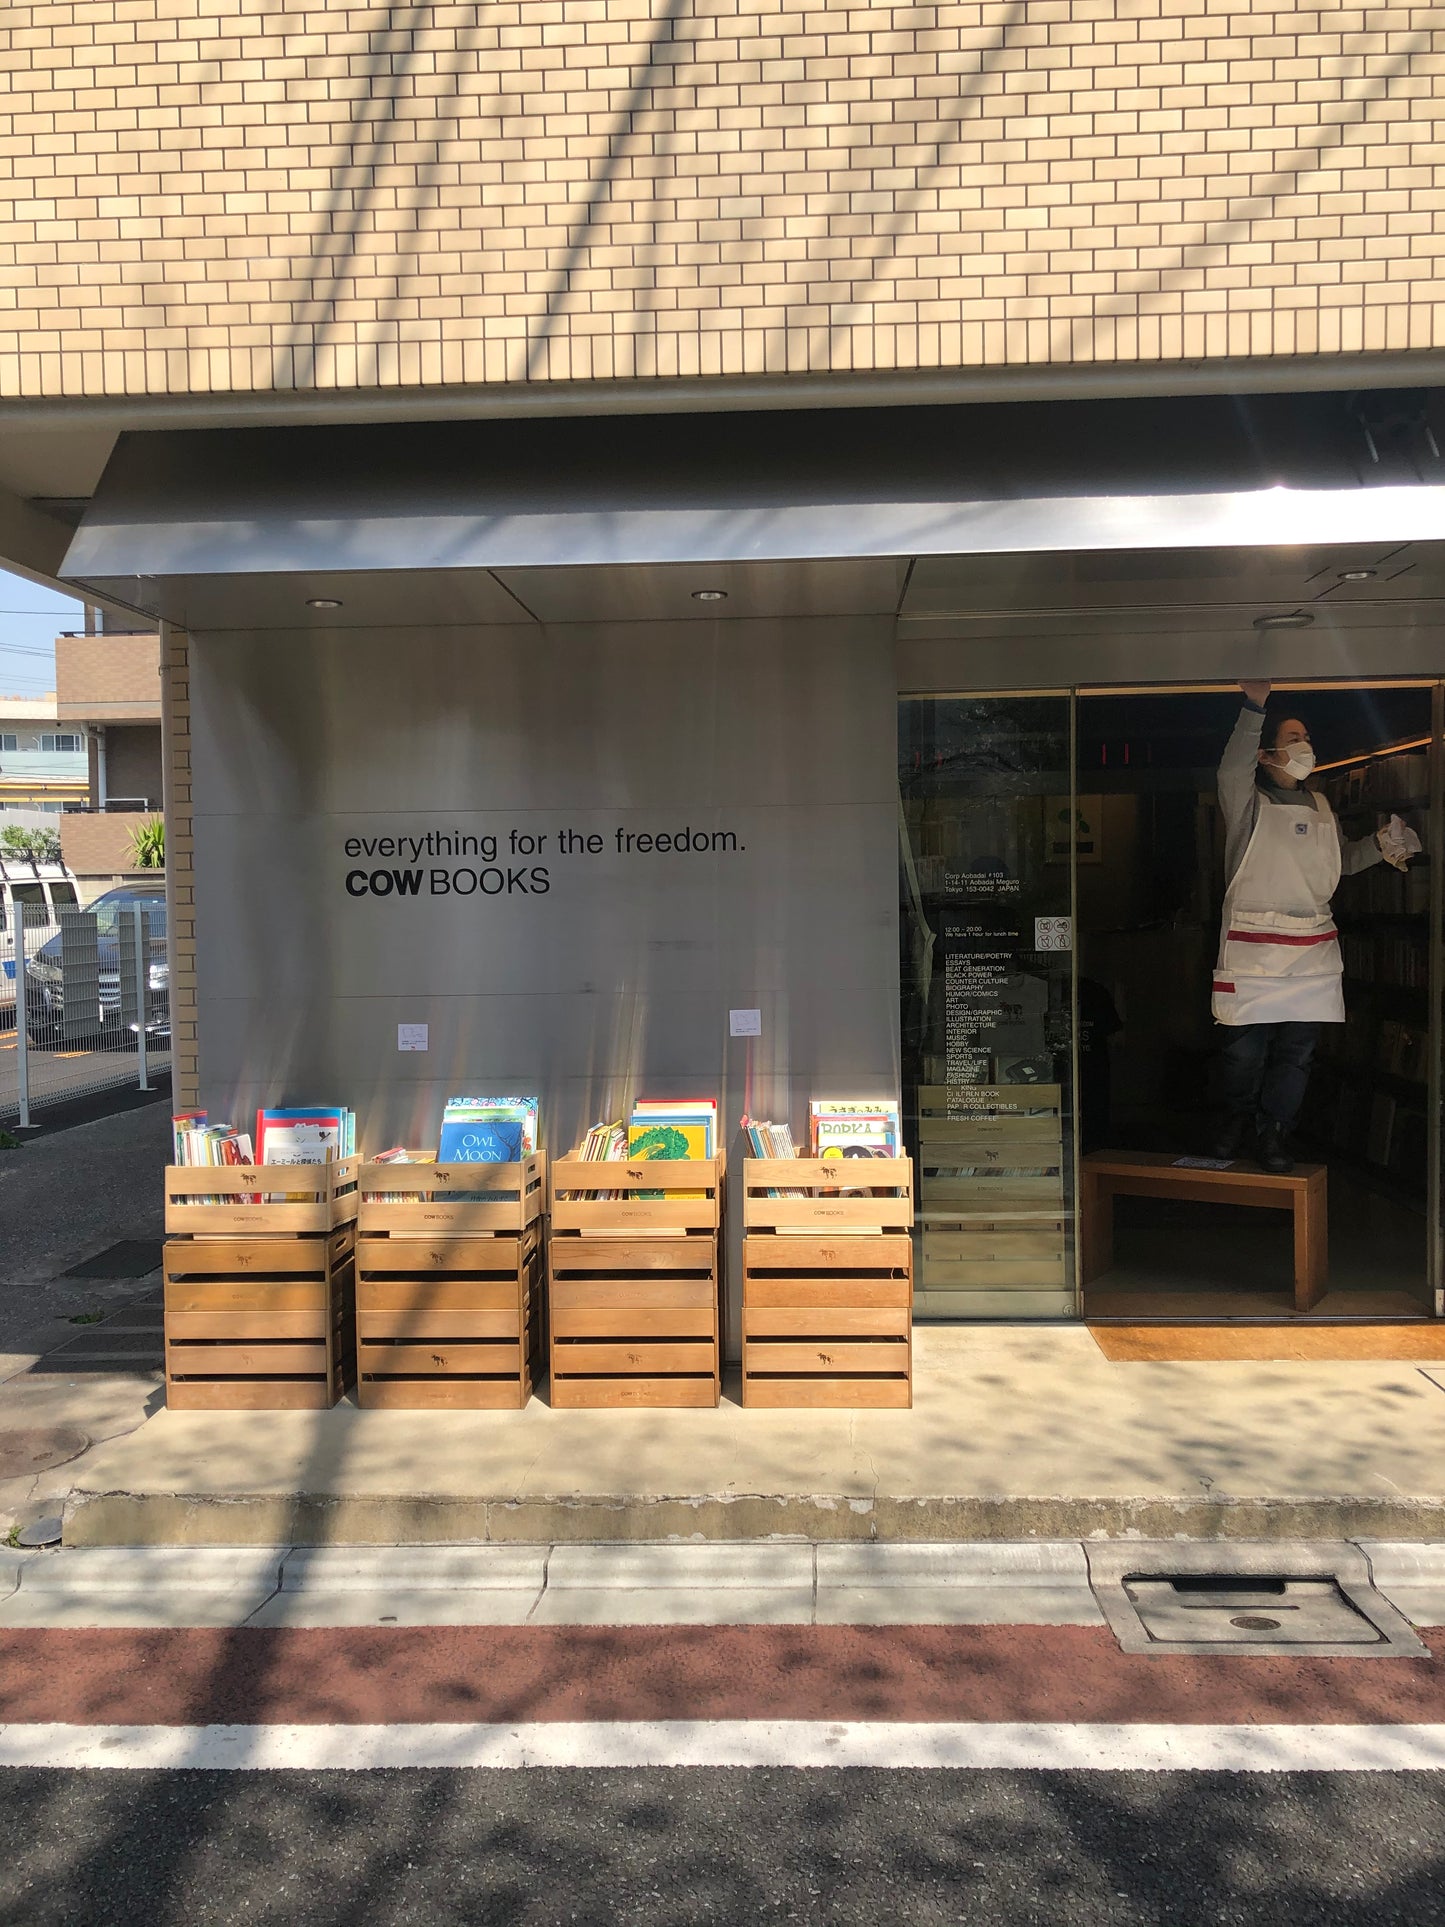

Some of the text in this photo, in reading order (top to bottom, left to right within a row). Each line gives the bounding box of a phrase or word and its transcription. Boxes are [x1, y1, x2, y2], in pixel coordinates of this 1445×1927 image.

[344, 827, 747, 862] everything for the freedom.
[462, 1134, 496, 1148] OWL
[454, 1149, 502, 1162] MOON
